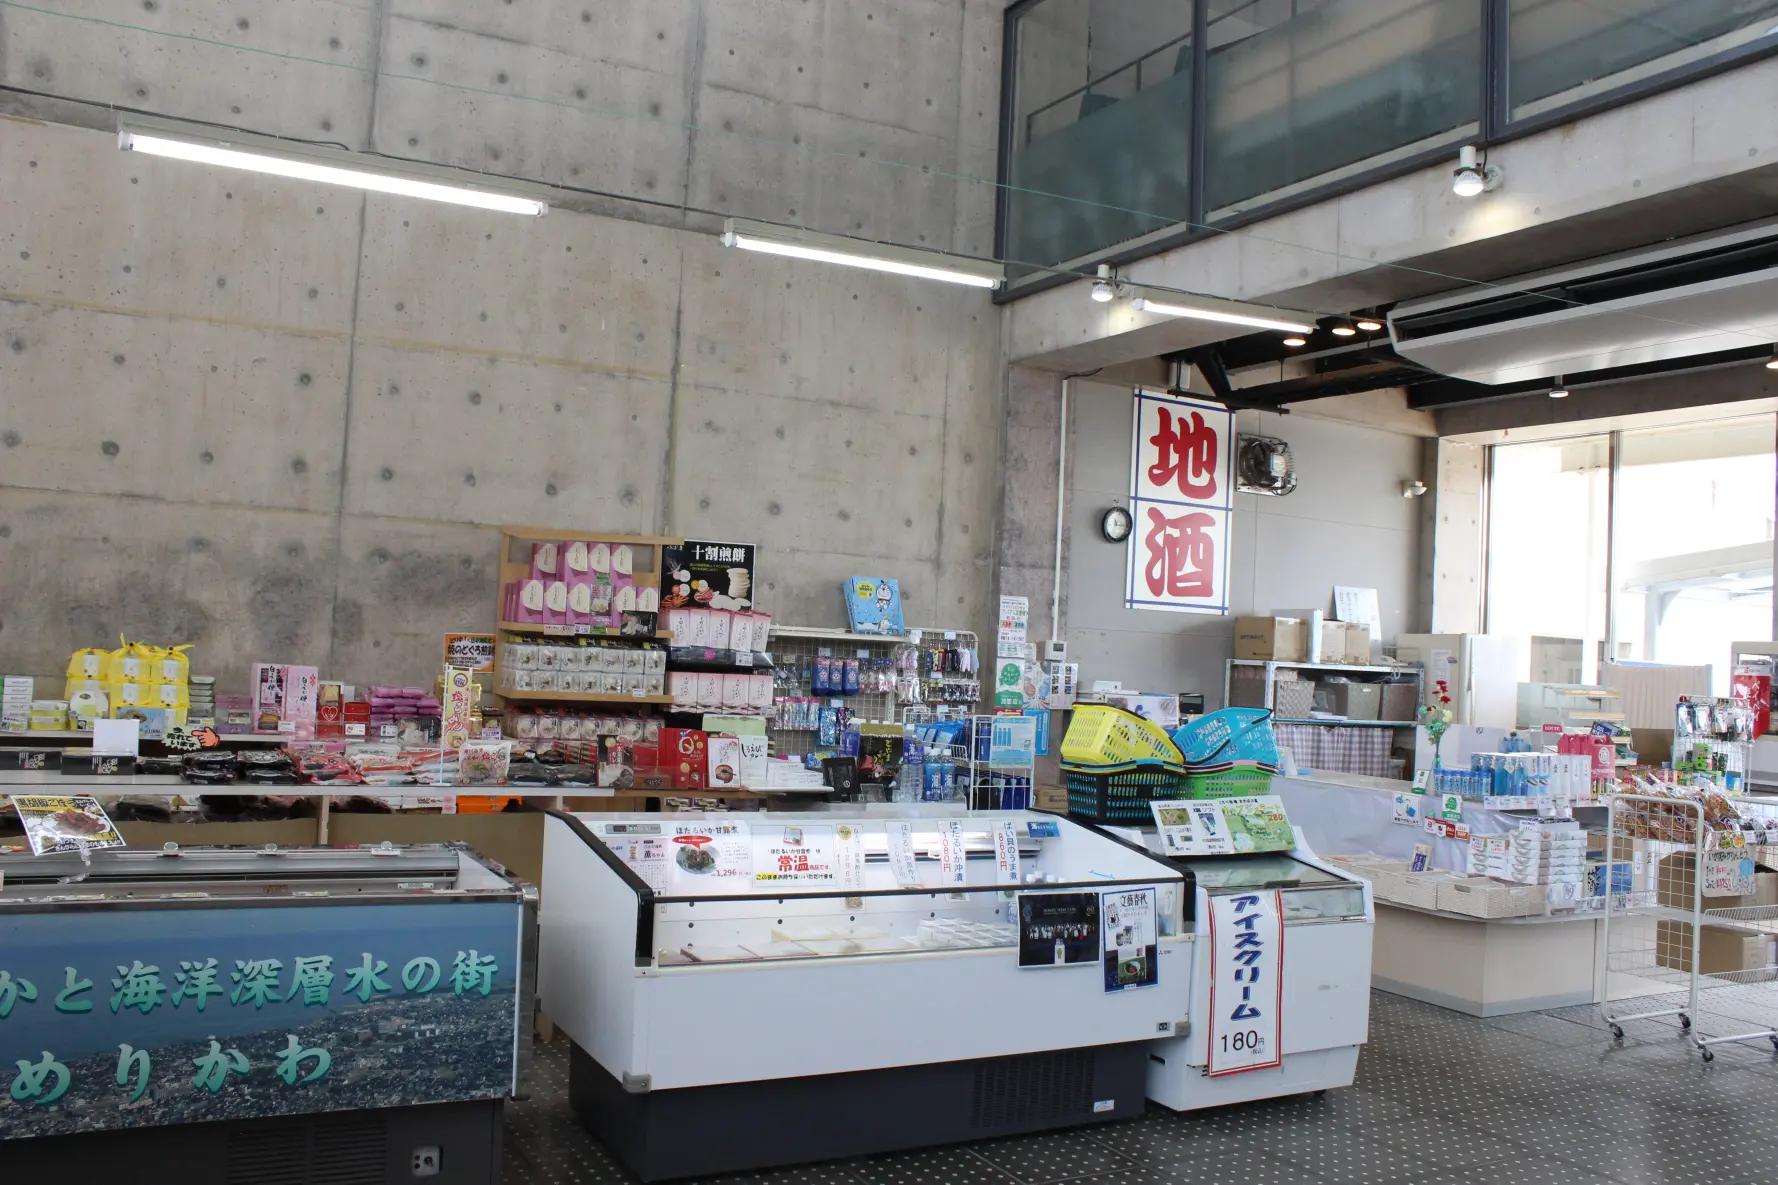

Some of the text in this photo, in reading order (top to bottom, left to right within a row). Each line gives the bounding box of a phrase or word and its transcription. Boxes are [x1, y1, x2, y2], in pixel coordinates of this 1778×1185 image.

[1145, 406, 1218, 598] 地酒
[1752, 680, 1761, 722] ペイペイ
[166, 733, 194, 742] 売れて
[173, 726, 184, 734] 今、
[170, 739, 197, 748] います
[1268, 813, 1285, 822] 280
[675, 825, 740, 835] ほたるいか甘露煮
[942, 831, 951, 872] 1080円
[998, 833, 1008, 871] 860円
[716, 868, 738, 878] 1,296
[1229, 895, 1265, 1022] アイスクリーム
[0, 949, 500, 1019] かと海洋深層水の街
